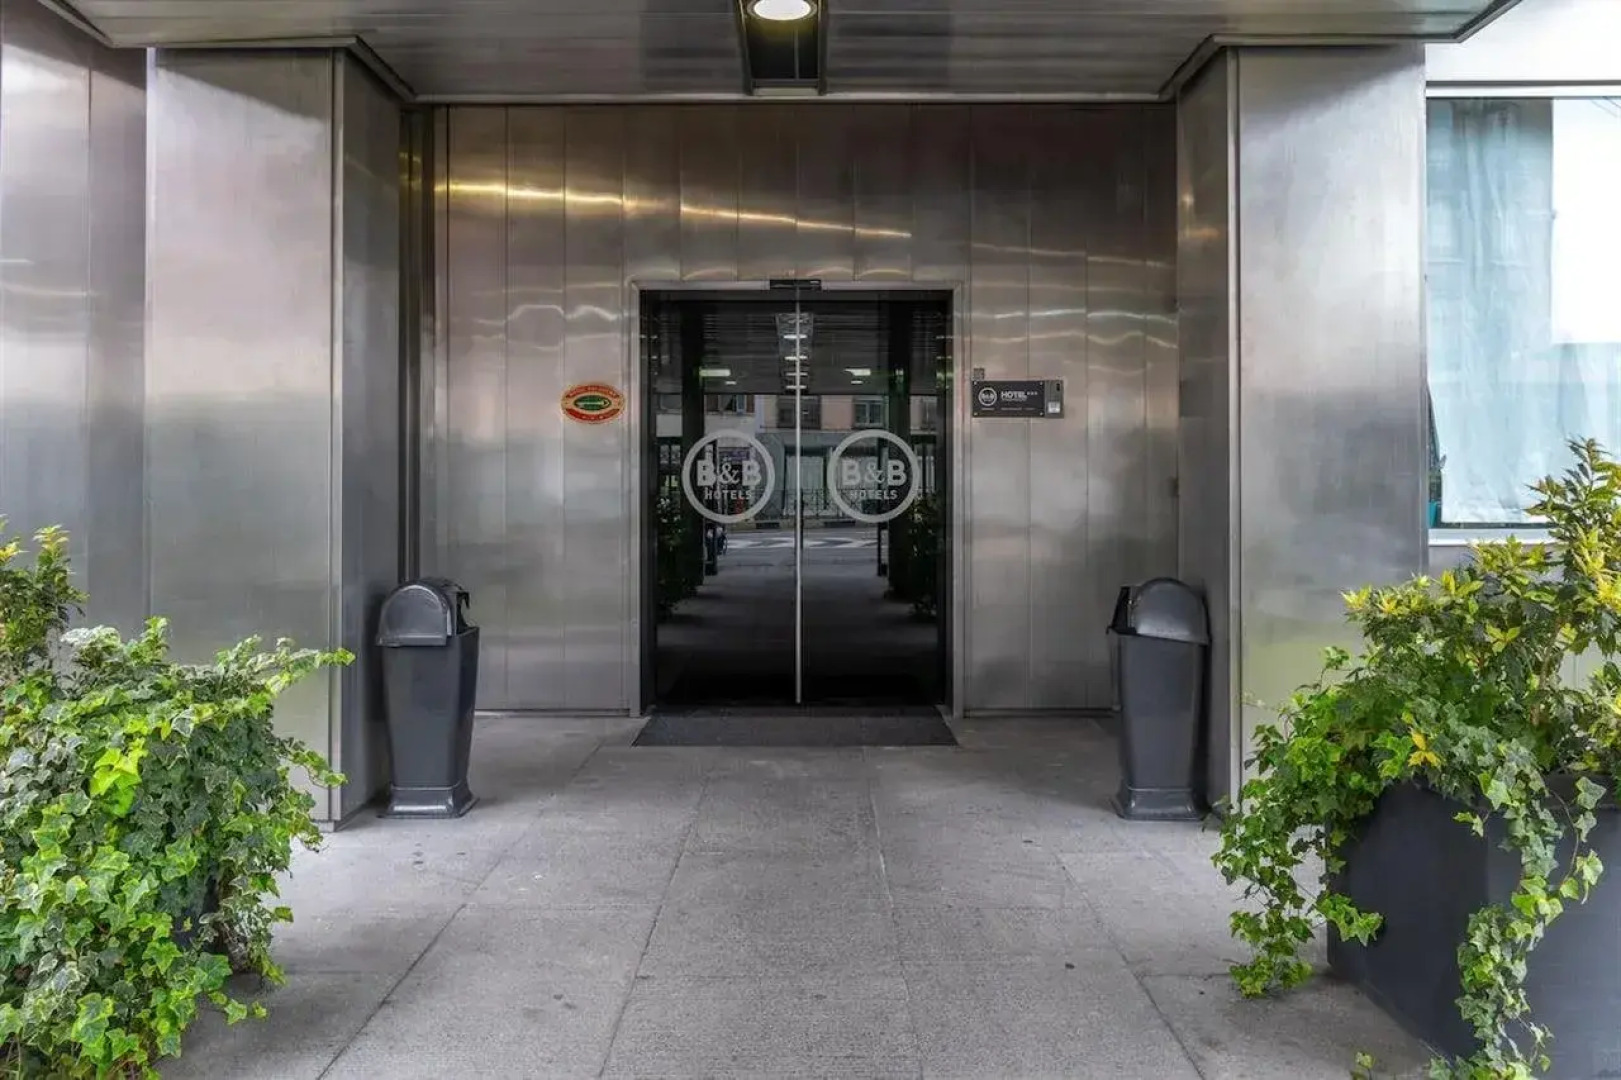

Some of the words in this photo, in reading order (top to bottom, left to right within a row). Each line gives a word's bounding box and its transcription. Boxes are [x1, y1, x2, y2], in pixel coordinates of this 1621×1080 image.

[697, 460, 761, 486] B&B
[842, 460, 907, 486] B&B
[704, 490, 752, 500] HOTELS
[850, 490, 898, 500] HOTELS
